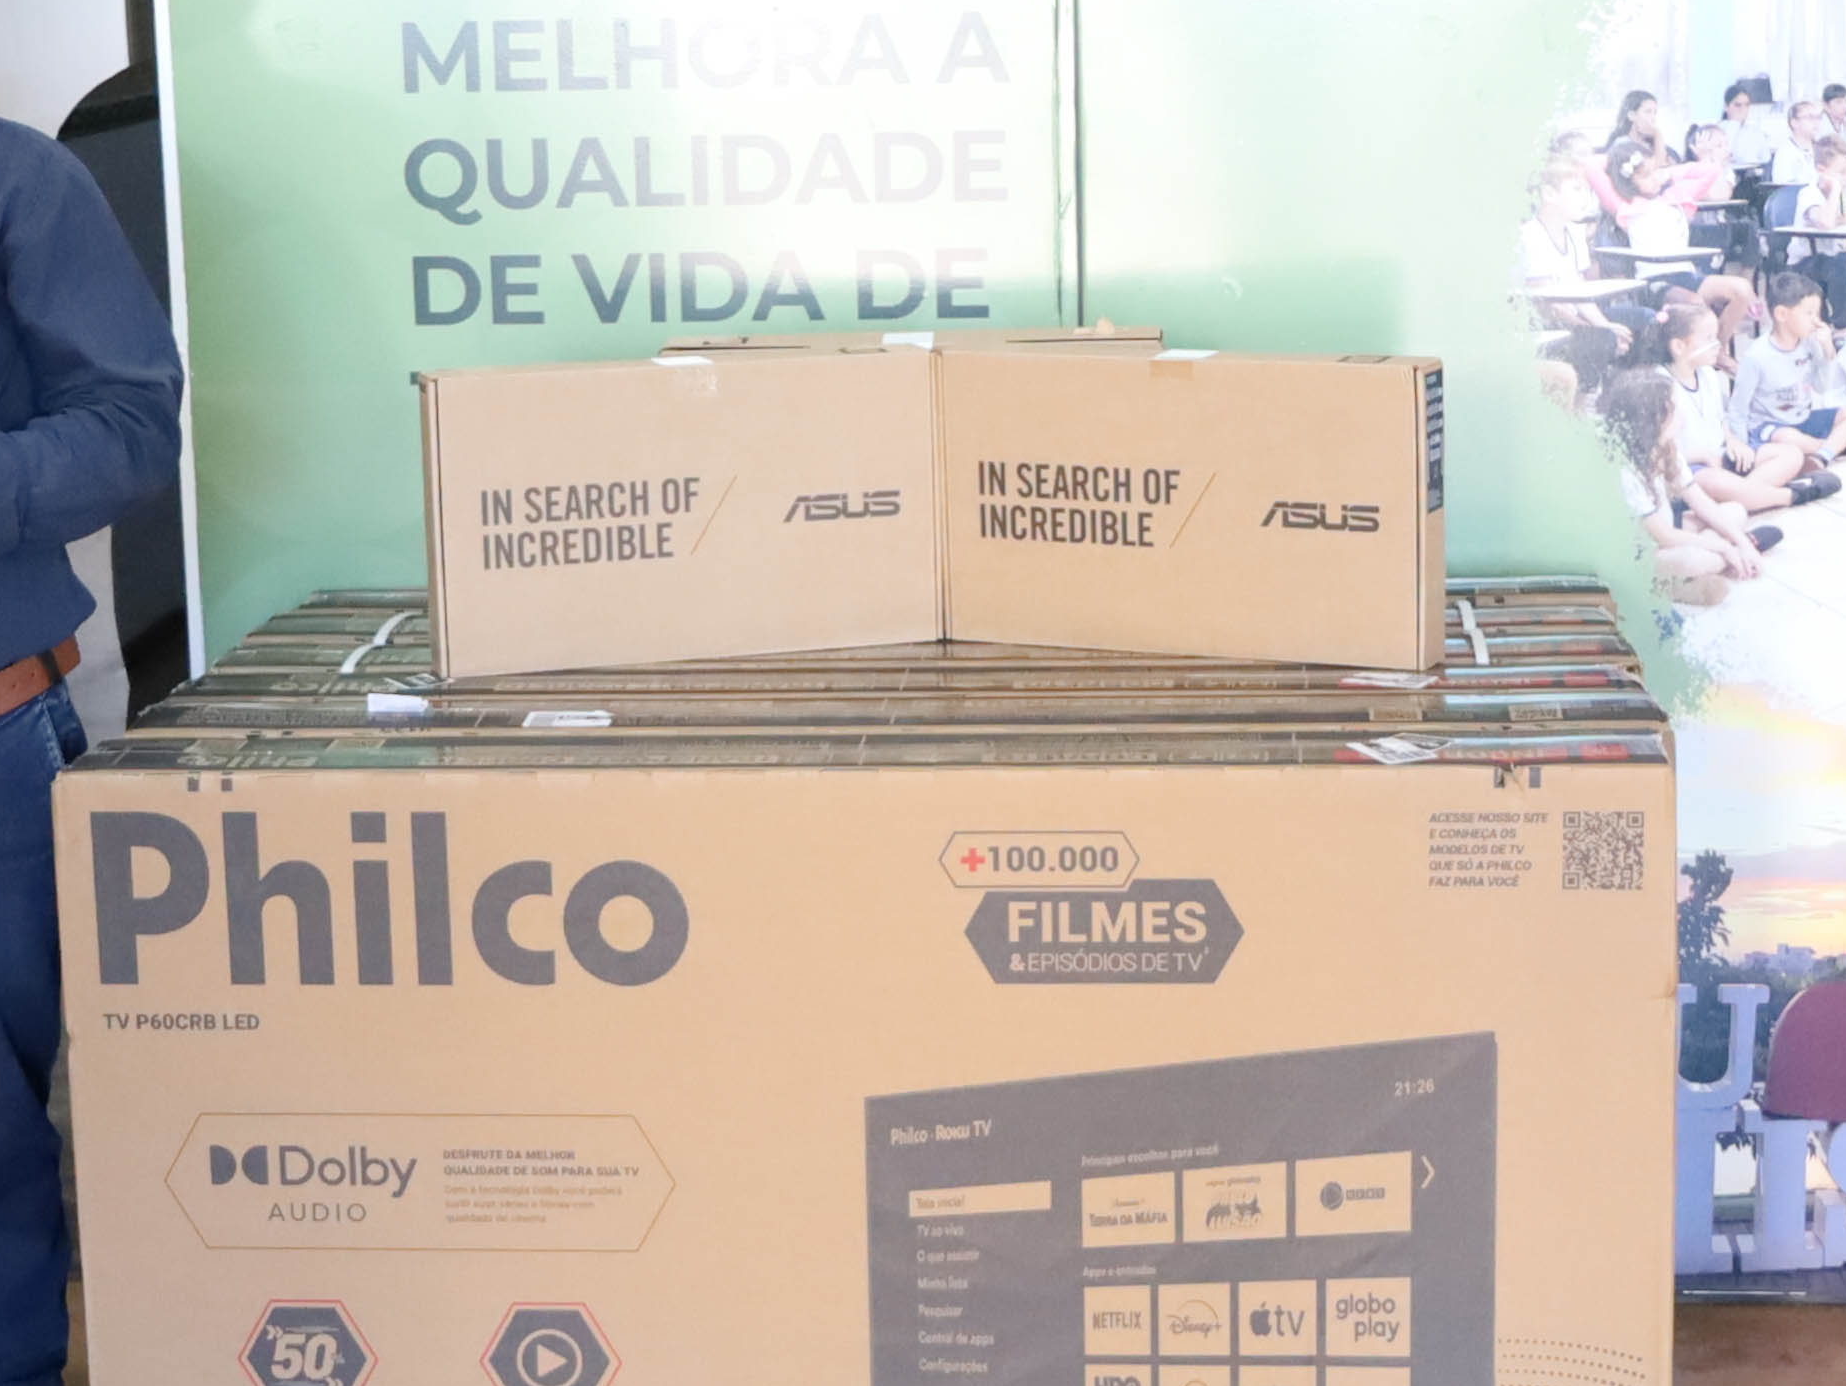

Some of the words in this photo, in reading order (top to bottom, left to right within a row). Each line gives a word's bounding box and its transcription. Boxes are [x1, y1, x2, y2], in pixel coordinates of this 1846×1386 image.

[400, 14, 912, 96] MELHORA
[936, 11, 1012, 86] A
[402, 129, 1012, 227] QUALIDADE
[410, 253, 547, 327] DE
[571, 250, 827, 325] VIDA
[855, 246, 991, 321] DE
[977, 460, 1007, 497] IN
[1016, 462, 1130, 502] SEARCH
[1142, 468, 1182, 505] OF
[480, 488, 514, 527] IN
[524, 480, 648, 524] SEARCH
[662, 476, 701, 515] OF
[782, 489, 902, 524] ASUS
[979, 501, 1156, 548] INCREDIBLE
[1260, 499, 1381, 533] ASUS
[482, 521, 675, 571] INCREDIBLE
[1428, 812, 1476, 824] ACESSE
[1477, 812, 1521, 824] NOSSO
[1522, 812, 1550, 824] SITE
[1428, 828, 1437, 839] E
[1438, 828, 1498, 842] CONHEÇA
[1500, 828, 1517, 839] OS
[960, 845, 1120, 873] +100.000
[1428, 844, 1488, 855] MODELOS
[1490, 844, 1508, 855] DE
[1509, 844, 1525, 855] TV
[1428, 860, 1454, 871] QUE
[1456, 858, 1473, 871] SÓ
[1475, 860, 1484, 871] A
[1486, 860, 1533, 871] PHILCO
[1428, 876, 1451, 887] FAZ
[1453, 876, 1485, 887] PARA
[1488, 874, 1520, 887] VOCÊ
[89, 810, 691, 987] Philco
[1007, 900, 1208, 945] FILMES
[1141, 952, 1169, 973] DE
[103, 1013, 131, 1030] TV
[135, 1013, 217, 1031] P60CRB
[222, 1014, 261, 1031] LED
[890, 1126, 929, 1146] Philco
[973, 1119, 992, 1138] TV
[506, 1149, 523, 1160] DA
[278, 1144, 418, 1199] Dolby
[513, 1166, 528, 1176] DE
[531, 1166, 559, 1177] SOM
[561, 1166, 593, 1177] PARA
[596, 1166, 621, 1177] SUA
[624, 1166, 640, 1177] TV
[267, 1202, 367, 1223] AUDIO
[1092, 1310, 1142, 1330] NETFLIX
[1336, 1292, 1396, 1320] globo
[1353, 1317, 1401, 1343] play
